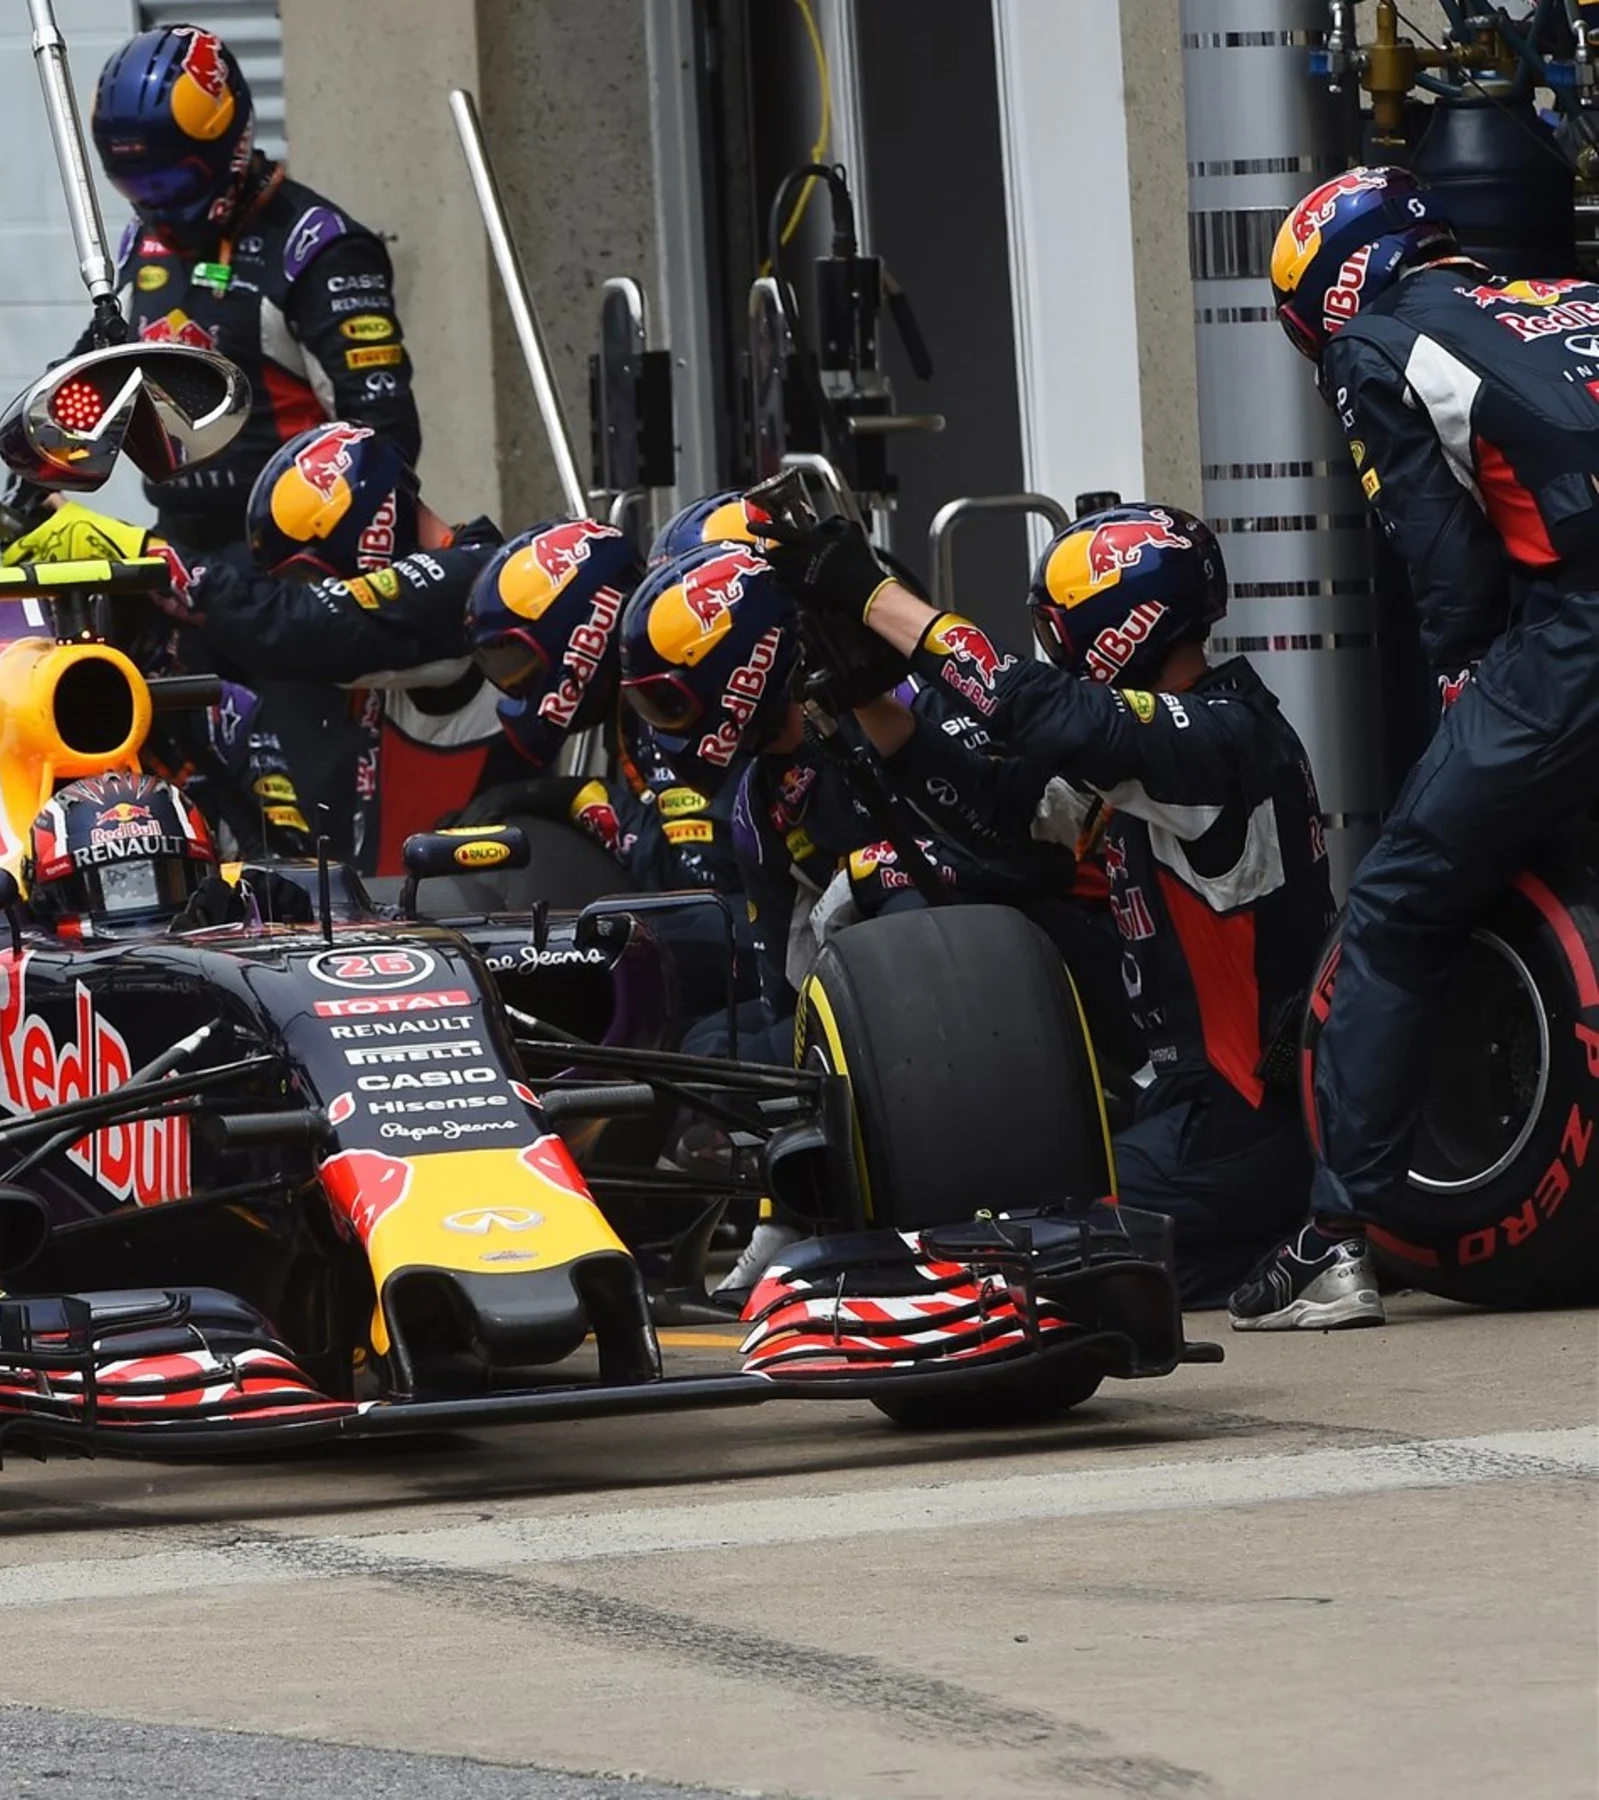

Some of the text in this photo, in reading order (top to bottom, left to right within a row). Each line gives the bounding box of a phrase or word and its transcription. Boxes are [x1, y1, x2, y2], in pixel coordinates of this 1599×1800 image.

[74, 835, 185, 869] RENAULT
[469, 848, 502, 860] RAUCH
[332, 952, 416, 979] 26
[518, 945, 606, 975] Jeans
[321, 993, 464, 1016] TOTAL
[329, 1015, 474, 1039] RENAULT
[344, 1040, 484, 1066] PIRELLI
[357, 1066, 498, 1092] CASIO
[379, 1119, 520, 1141] Pepe Jeans
[1457, 1103, 1593, 1266] ZERO
